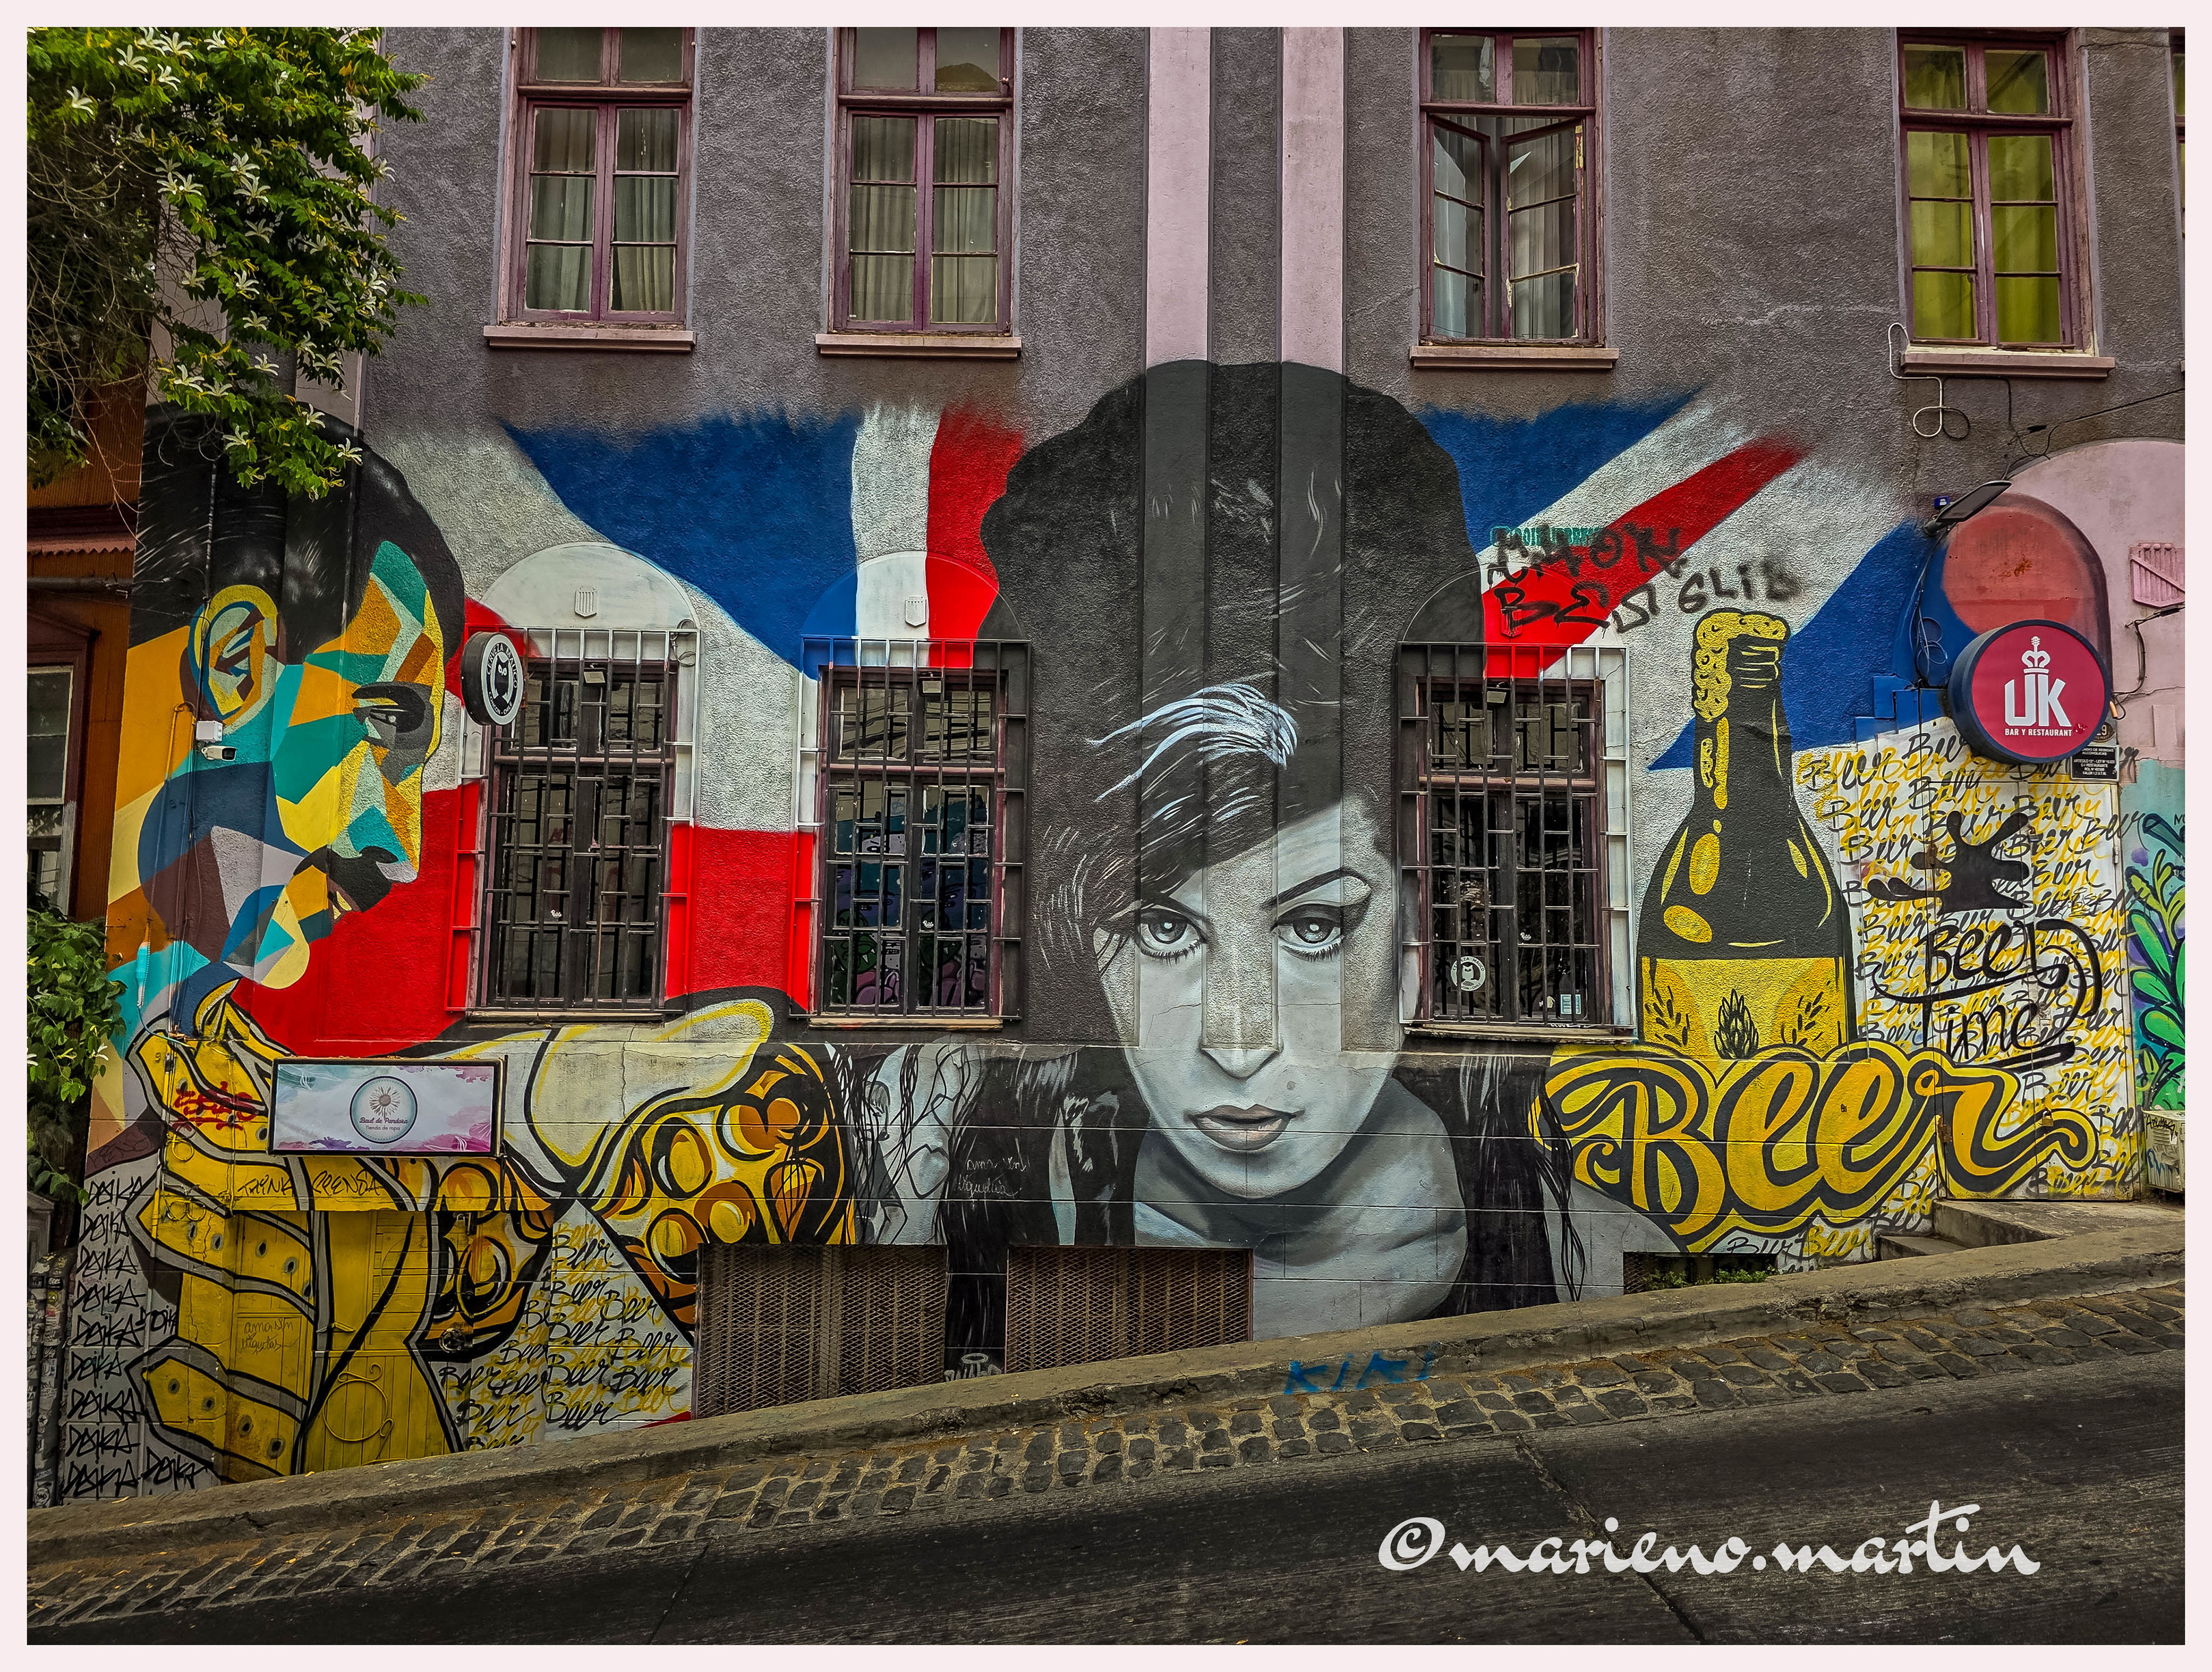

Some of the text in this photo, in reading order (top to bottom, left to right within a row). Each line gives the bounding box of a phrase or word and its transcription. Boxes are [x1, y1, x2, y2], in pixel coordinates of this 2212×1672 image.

[487, 643, 518, 688] CERVEZA MAUCO
[503, 701, 513, 715] CHILE
[2005, 674, 2073, 727] UK
[2005, 728, 2073, 737] BAR Y RESTAURANT
[1472, 958, 1484, 972] MAUCO
[1529, 1040, 2097, 1252] Beer
